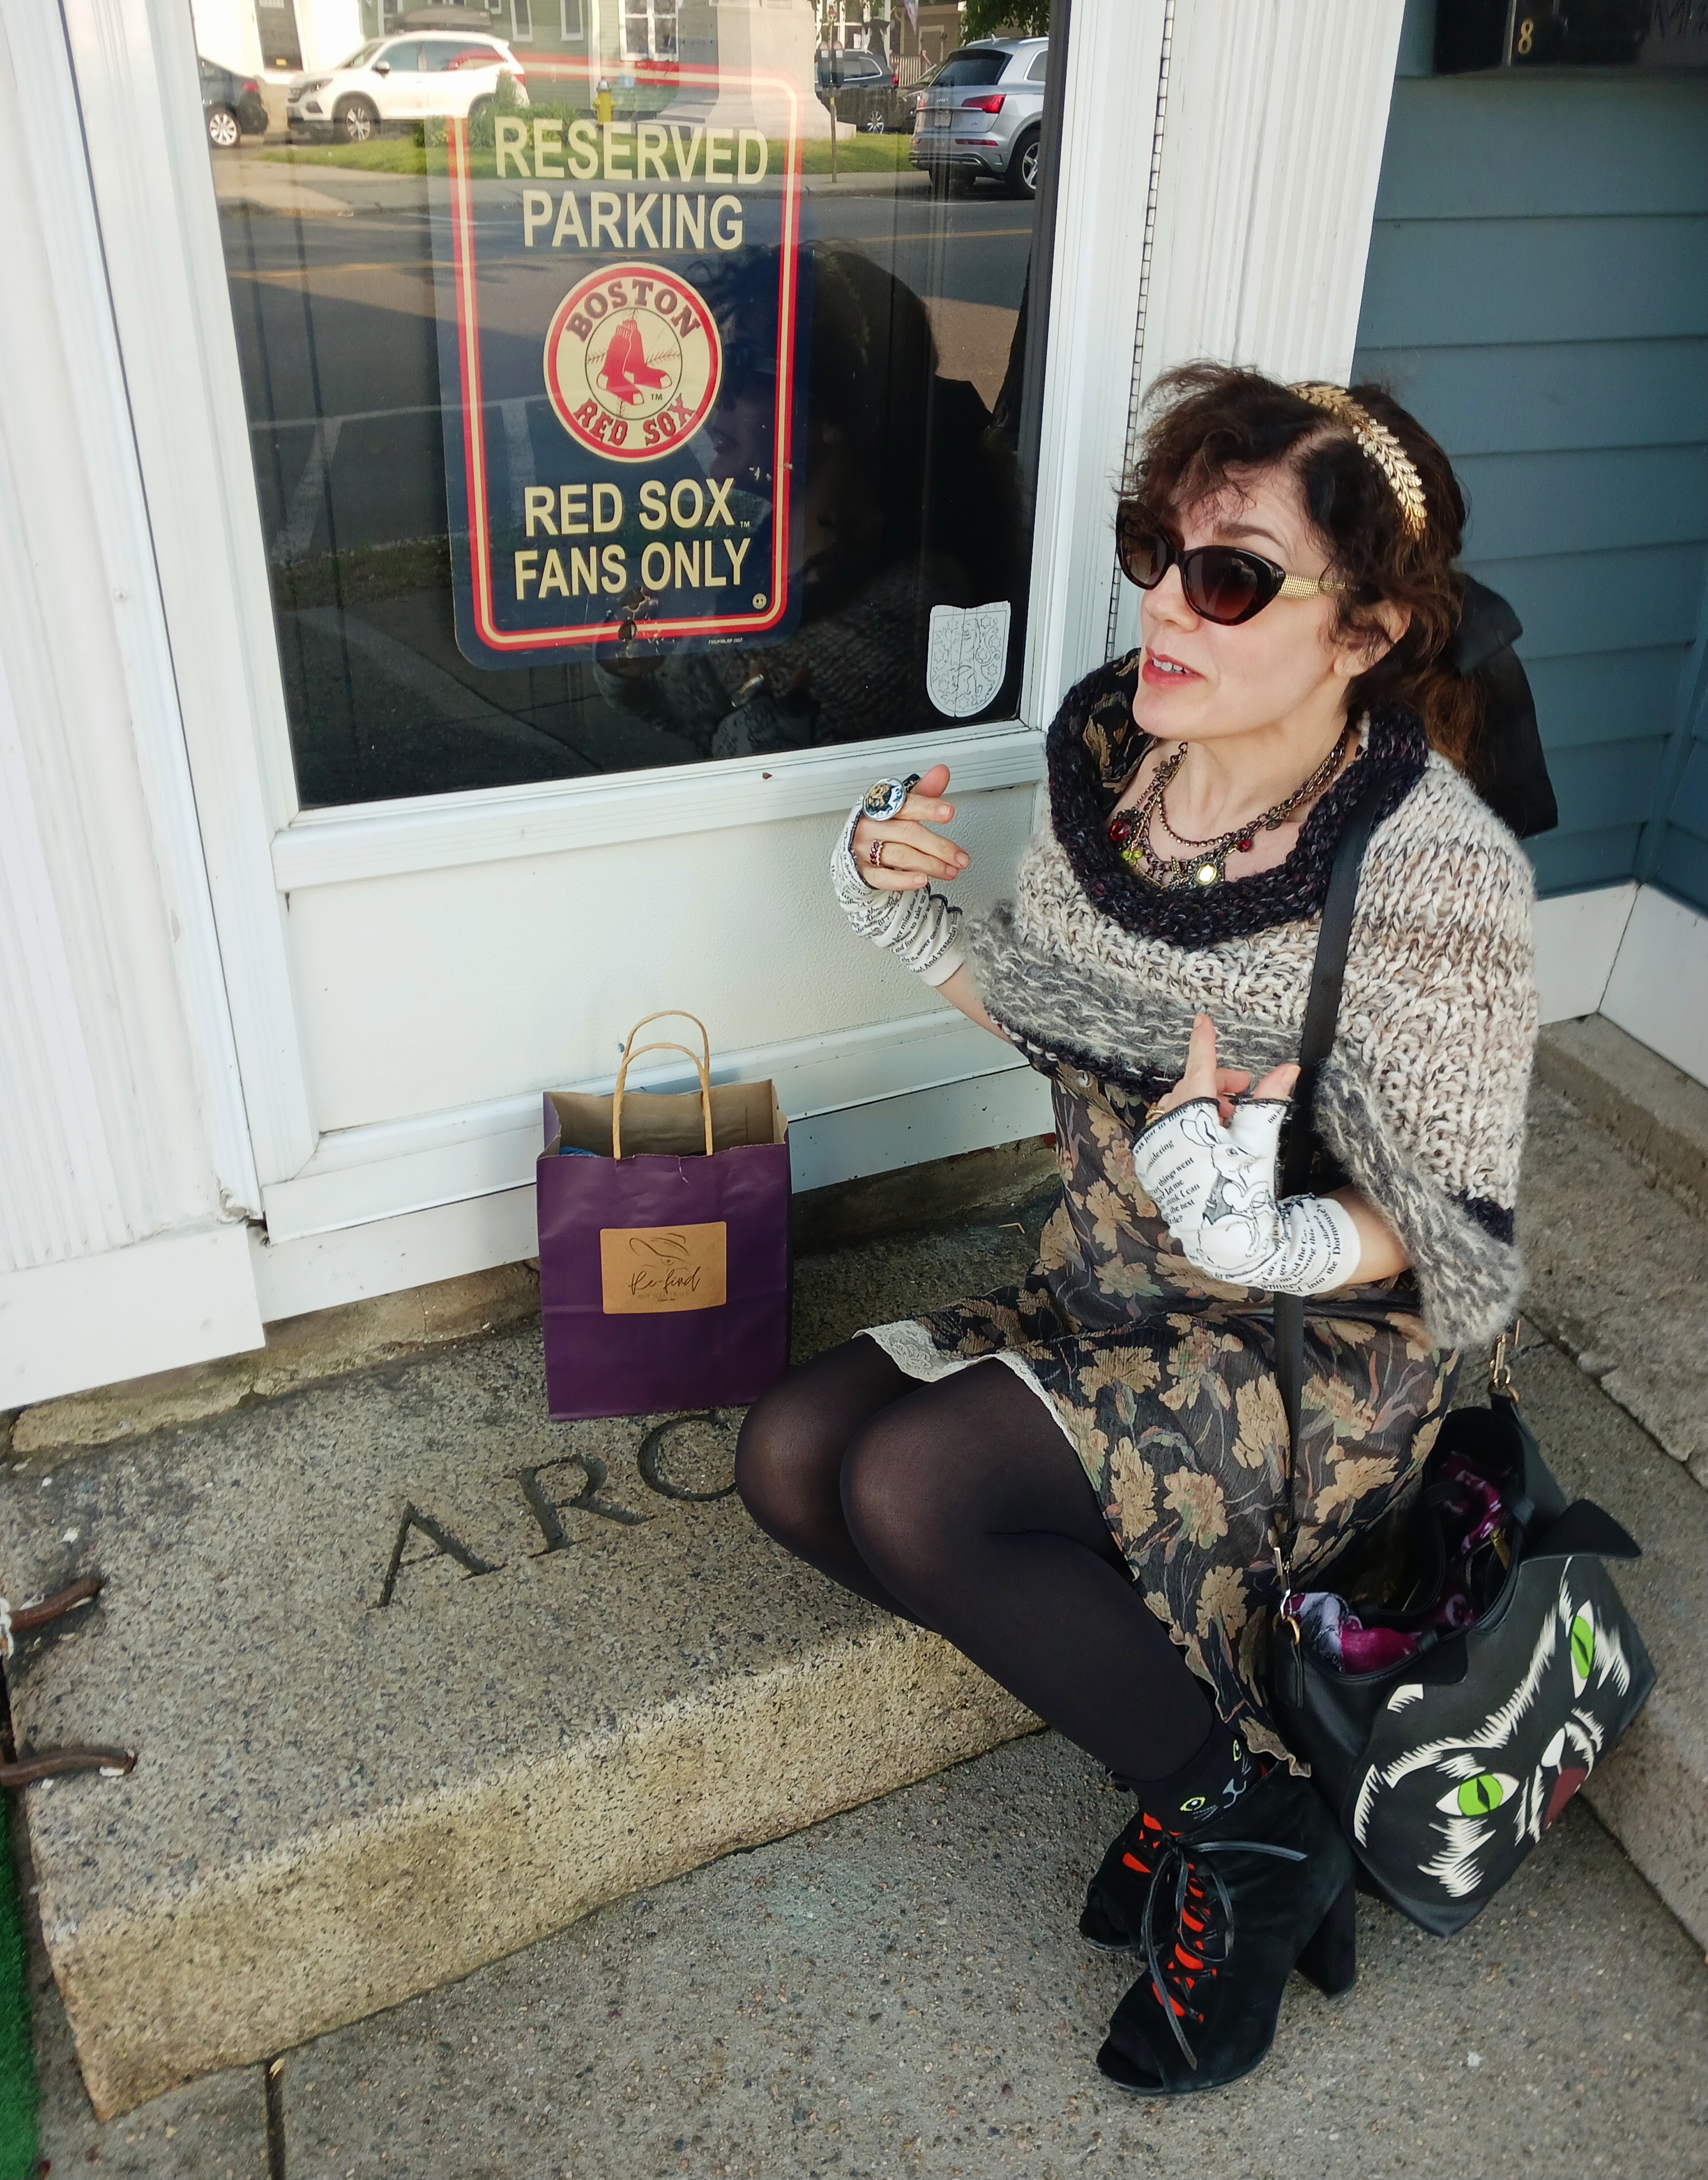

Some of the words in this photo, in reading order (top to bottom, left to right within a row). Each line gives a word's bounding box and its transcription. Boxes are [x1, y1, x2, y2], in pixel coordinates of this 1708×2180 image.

[1517, 18, 1534, 55] 8
[495, 116, 768, 184] RESERVED
[522, 189, 743, 251] PARKING
[565, 279, 701, 343] BOSTON
[573, 397, 628, 446] RED
[644, 393, 695, 446] SOX
[524, 483, 623, 537] RED
[639, 477, 735, 530] SOX
[514, 544, 627, 600] FANS
[641, 538, 750, 591] ONLY
[901, 909, 912, 930] mind
[917, 939, 930, 956] never
[924, 955, 938, 969] And
[936, 926, 958, 957] yesterday
[1158, 1169, 1176, 1187] things
[1176, 1157, 1194, 1171] went
[1186, 1184, 1200, 1195] can
[1180, 1199, 1195, 1210] next
[1298, 1246, 1306, 1261] the
[1307, 1277, 1325, 1290] into
[1326, 1261, 1338, 1275] the
